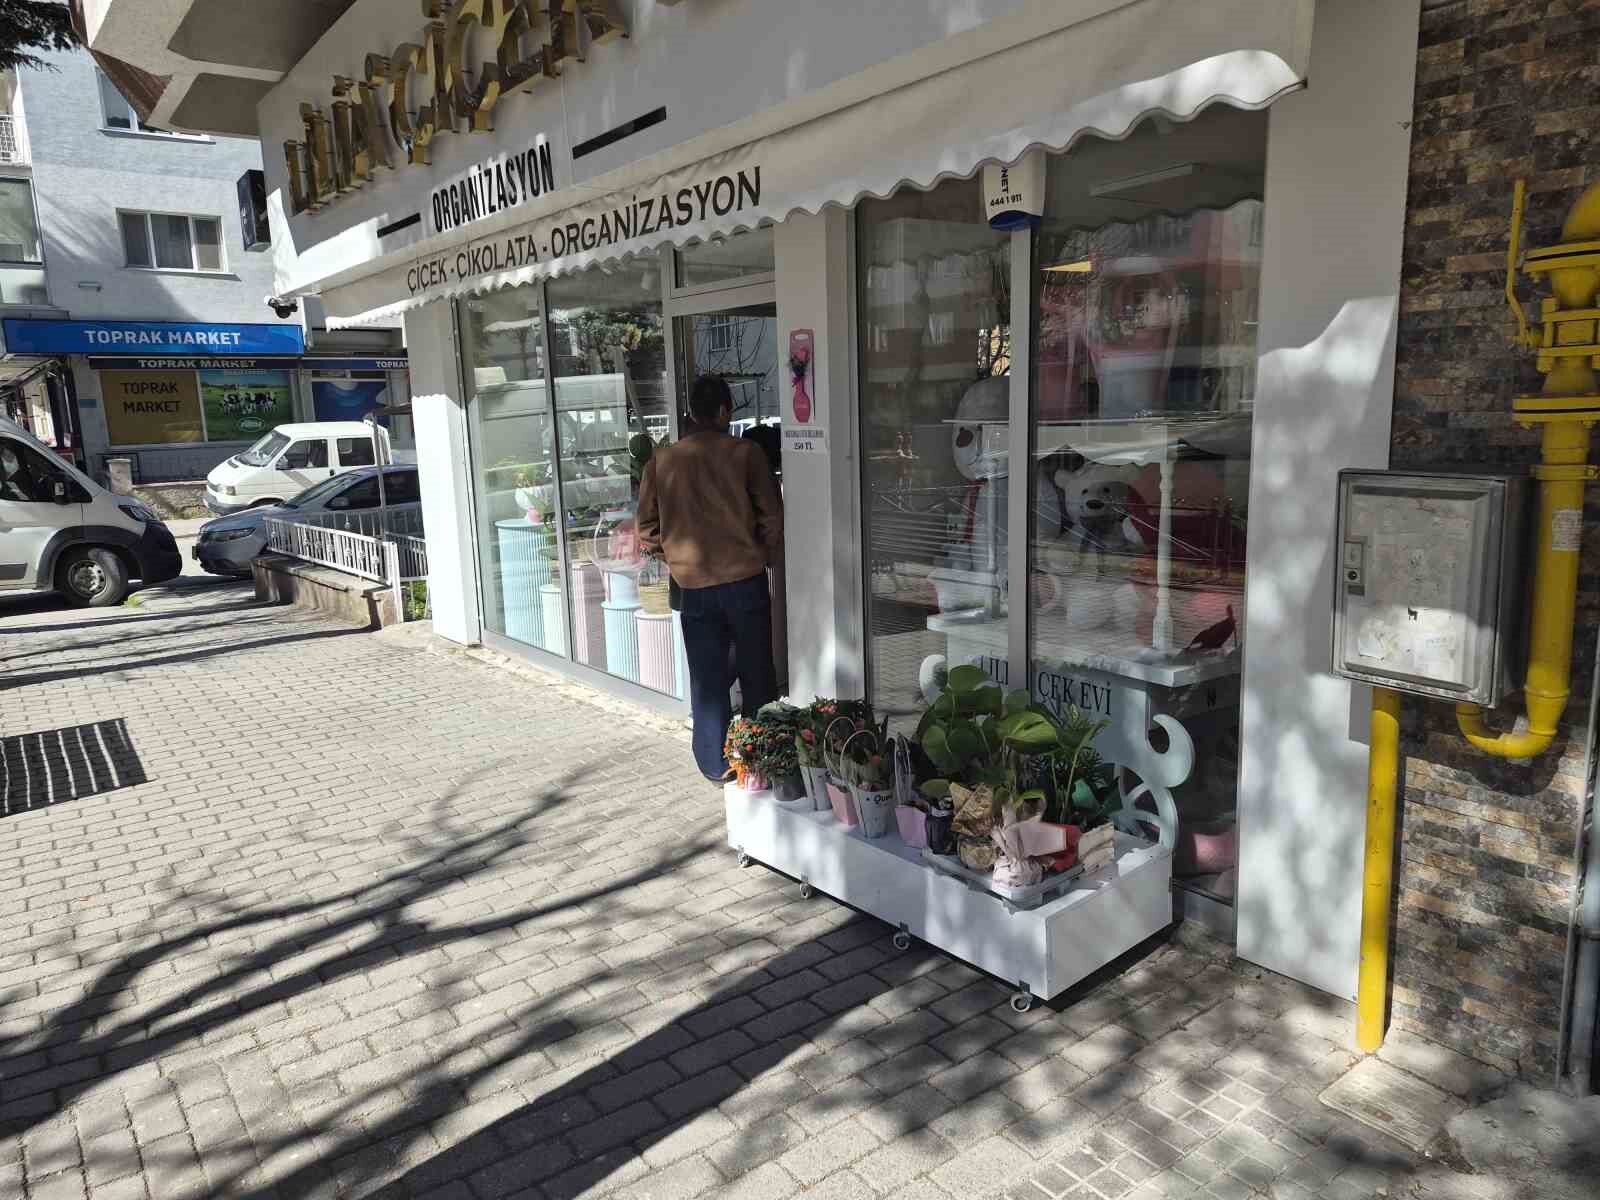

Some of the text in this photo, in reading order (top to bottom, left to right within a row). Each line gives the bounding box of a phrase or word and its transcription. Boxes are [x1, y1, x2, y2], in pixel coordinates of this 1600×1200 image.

[432, 141, 555, 233] ORGANİZASYON
[407, 165, 761, 296] ÇİÇEK ÇİKOLATA ORGANİZASYON
[84, 330, 241, 345] TOPRAK MARKET
[137, 359, 257, 369] TOPRAK MARKET
[120, 381, 178, 395] TOPRAK
[123, 400, 181, 414] MARKET
[1080, 681, 1111, 715] EVİ
